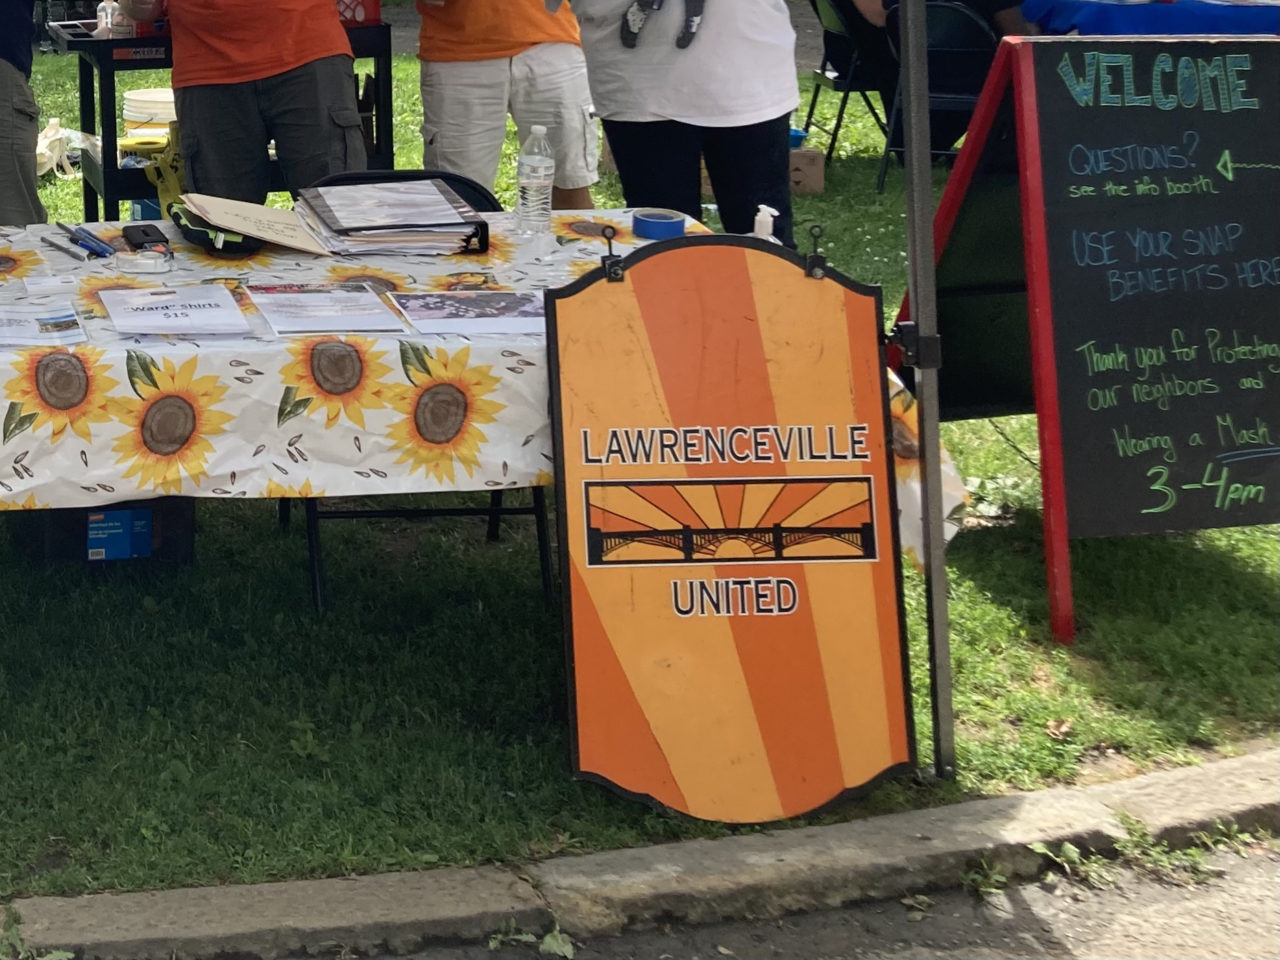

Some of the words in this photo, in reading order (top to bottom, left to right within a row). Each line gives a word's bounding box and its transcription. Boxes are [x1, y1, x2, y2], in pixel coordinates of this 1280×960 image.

[1057, 52, 1260, 112] WELCOME
[1069, 131, 1200, 176] QUESTIONS?
[1070, 185, 1097, 197] see
[1103, 181, 1131, 197] the
[1134, 176, 1160, 196] info
[1166, 175, 1220, 196] booth
[1073, 229, 1119, 266] USE
[1126, 228, 1177, 262] YOUR
[1182, 223, 1243, 256] SNAP
[1107, 264, 1229, 302] BENEFITS
[1075, 340, 1130, 376] Thank
[1135, 345, 1168, 381] you
[1170, 328, 1200, 361] for
[1204, 328, 1280, 373] Protecting
[1088, 385, 1122, 411] our
[1132, 372, 1220, 411] neighbors
[1239, 371, 1265, 389] and
[581, 424, 870, 465] LAWRENCEVILLE
[1113, 424, 1177, 463] Wearing
[1188, 432, 1204, 446] a
[1216, 413, 1276, 447] Mask
[672, 578, 797, 617] UNITED
